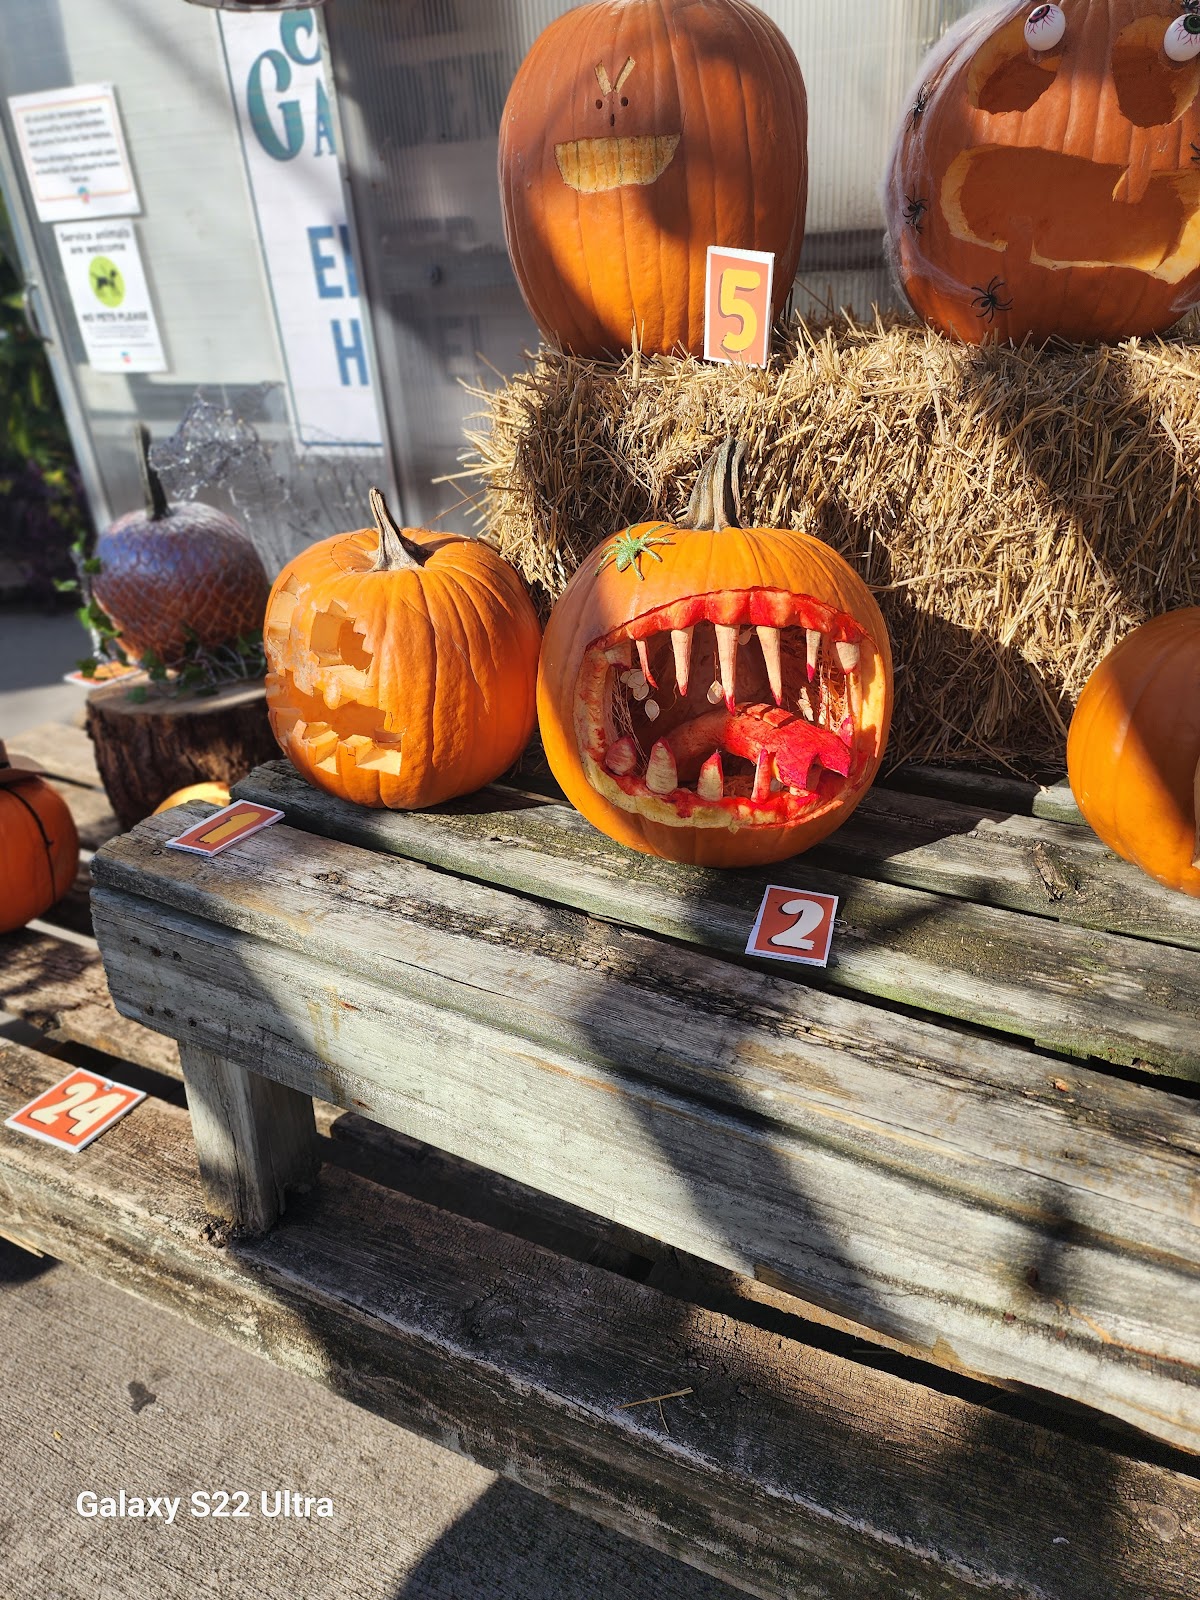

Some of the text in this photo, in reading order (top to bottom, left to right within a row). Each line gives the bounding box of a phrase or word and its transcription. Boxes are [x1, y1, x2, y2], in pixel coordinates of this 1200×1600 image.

[60, 228, 131, 242] Service animals
[87, 243, 126, 253] welcome
[117, 311, 149, 321] PLEASE
[718, 268, 761, 354] 5
[195, 812, 261, 844] 1
[768, 899, 825, 951] 2
[28, 1082, 127, 1137] 24
